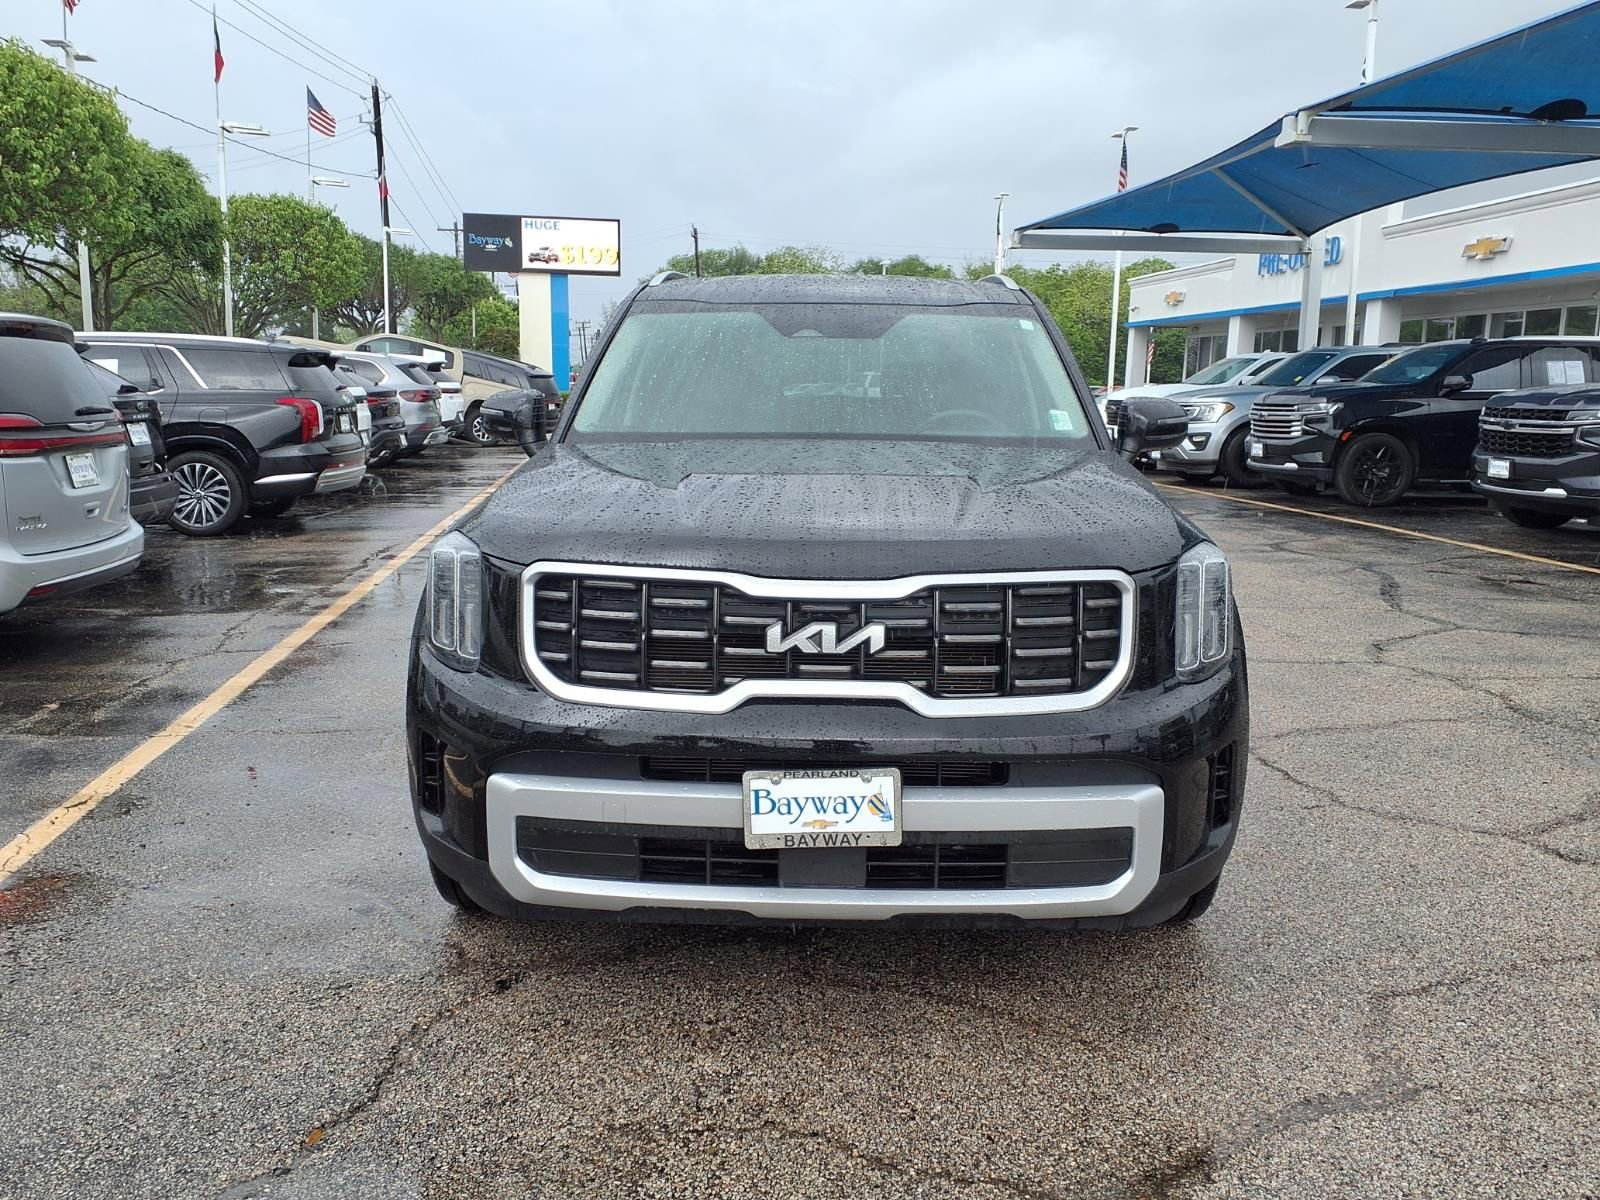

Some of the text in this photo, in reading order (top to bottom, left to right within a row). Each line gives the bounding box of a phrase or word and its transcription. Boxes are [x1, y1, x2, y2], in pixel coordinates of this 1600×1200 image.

[524, 220, 560, 231] HUGE
[468, 233, 504, 248] Bayway
[560, 244, 618, 265] $199
[766, 620, 886, 654] KIA
[783, 770, 860, 779] PEARLAND
[751, 788, 868, 825] Bayway
[784, 833, 863, 848] BAYWAY
